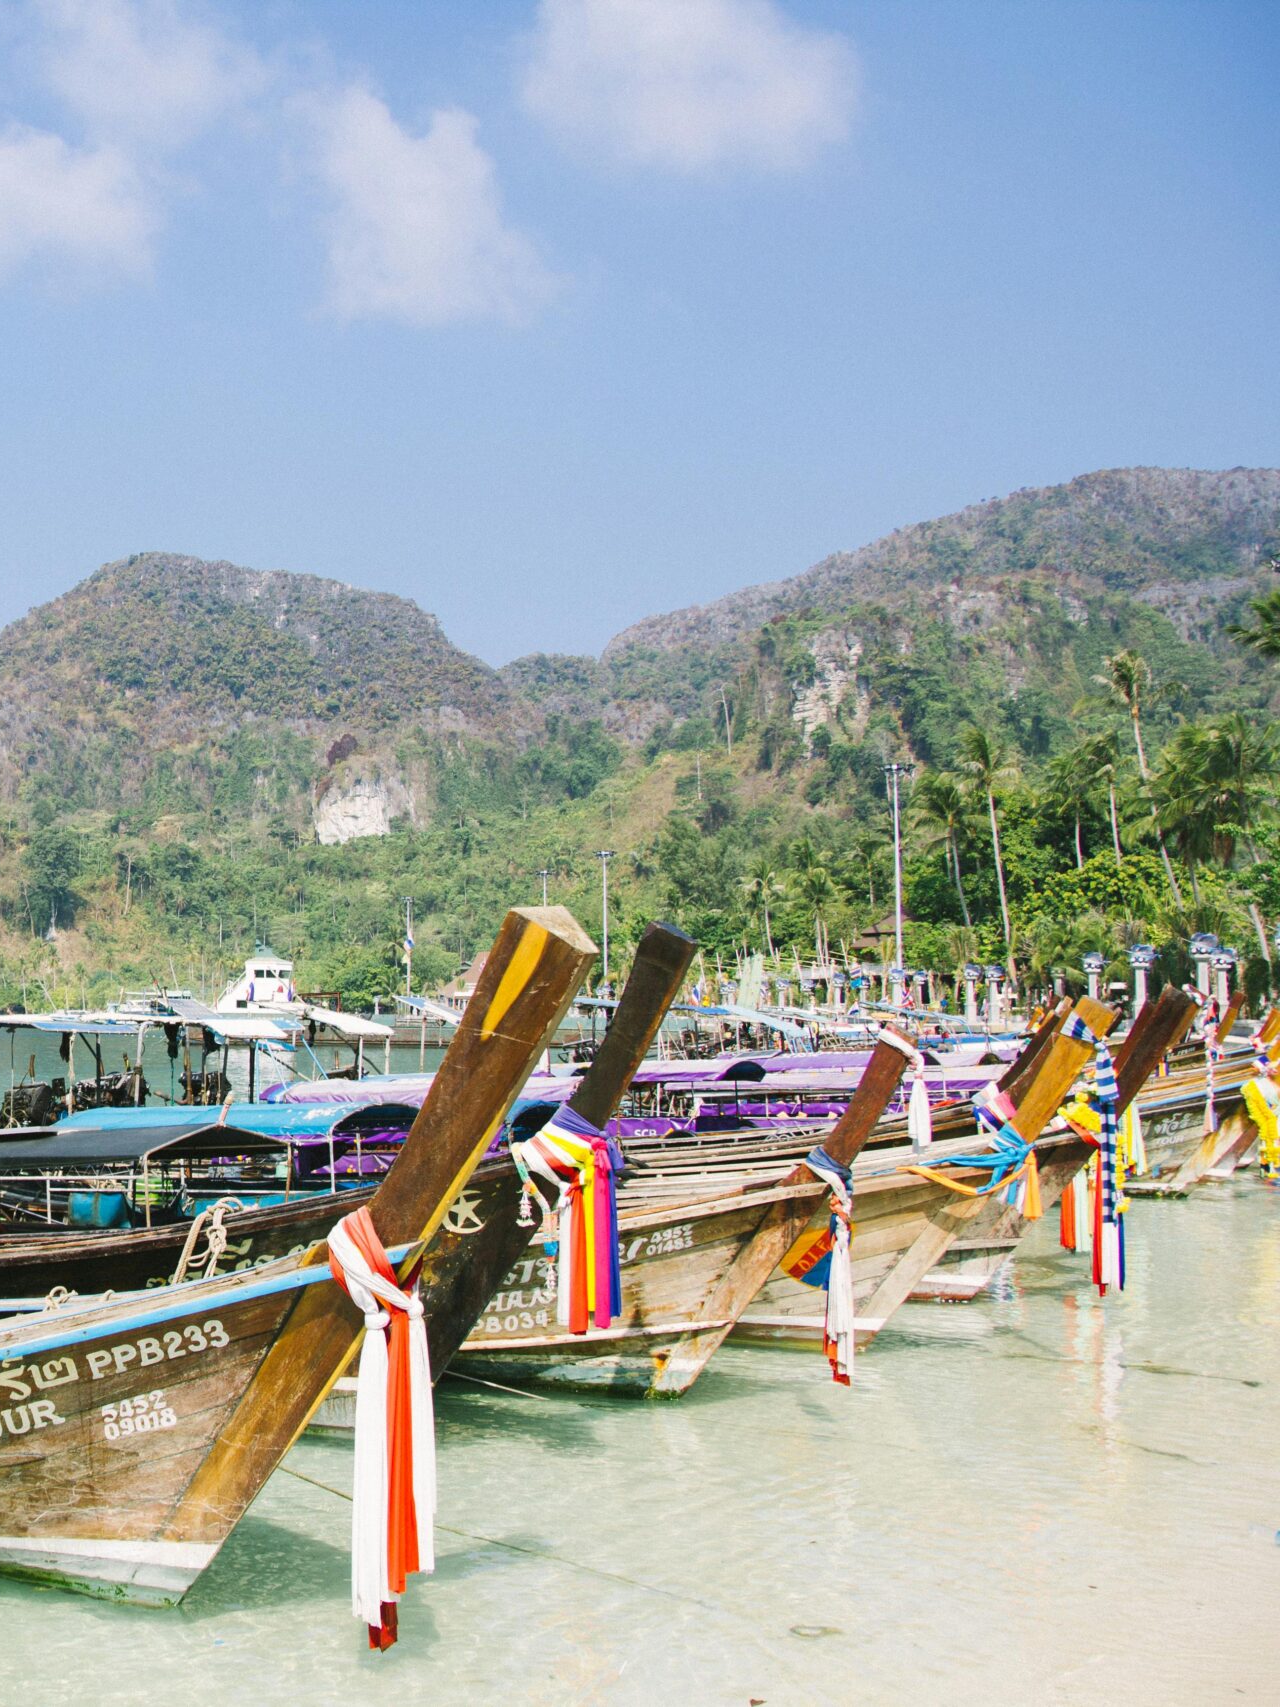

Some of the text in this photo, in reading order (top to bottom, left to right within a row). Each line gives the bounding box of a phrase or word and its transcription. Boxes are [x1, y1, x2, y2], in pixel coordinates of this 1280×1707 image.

[86, 1320, 230, 1380] PPB233
[102, 1390, 167, 1423] 5452
[104, 1407, 177, 1440] 09018
